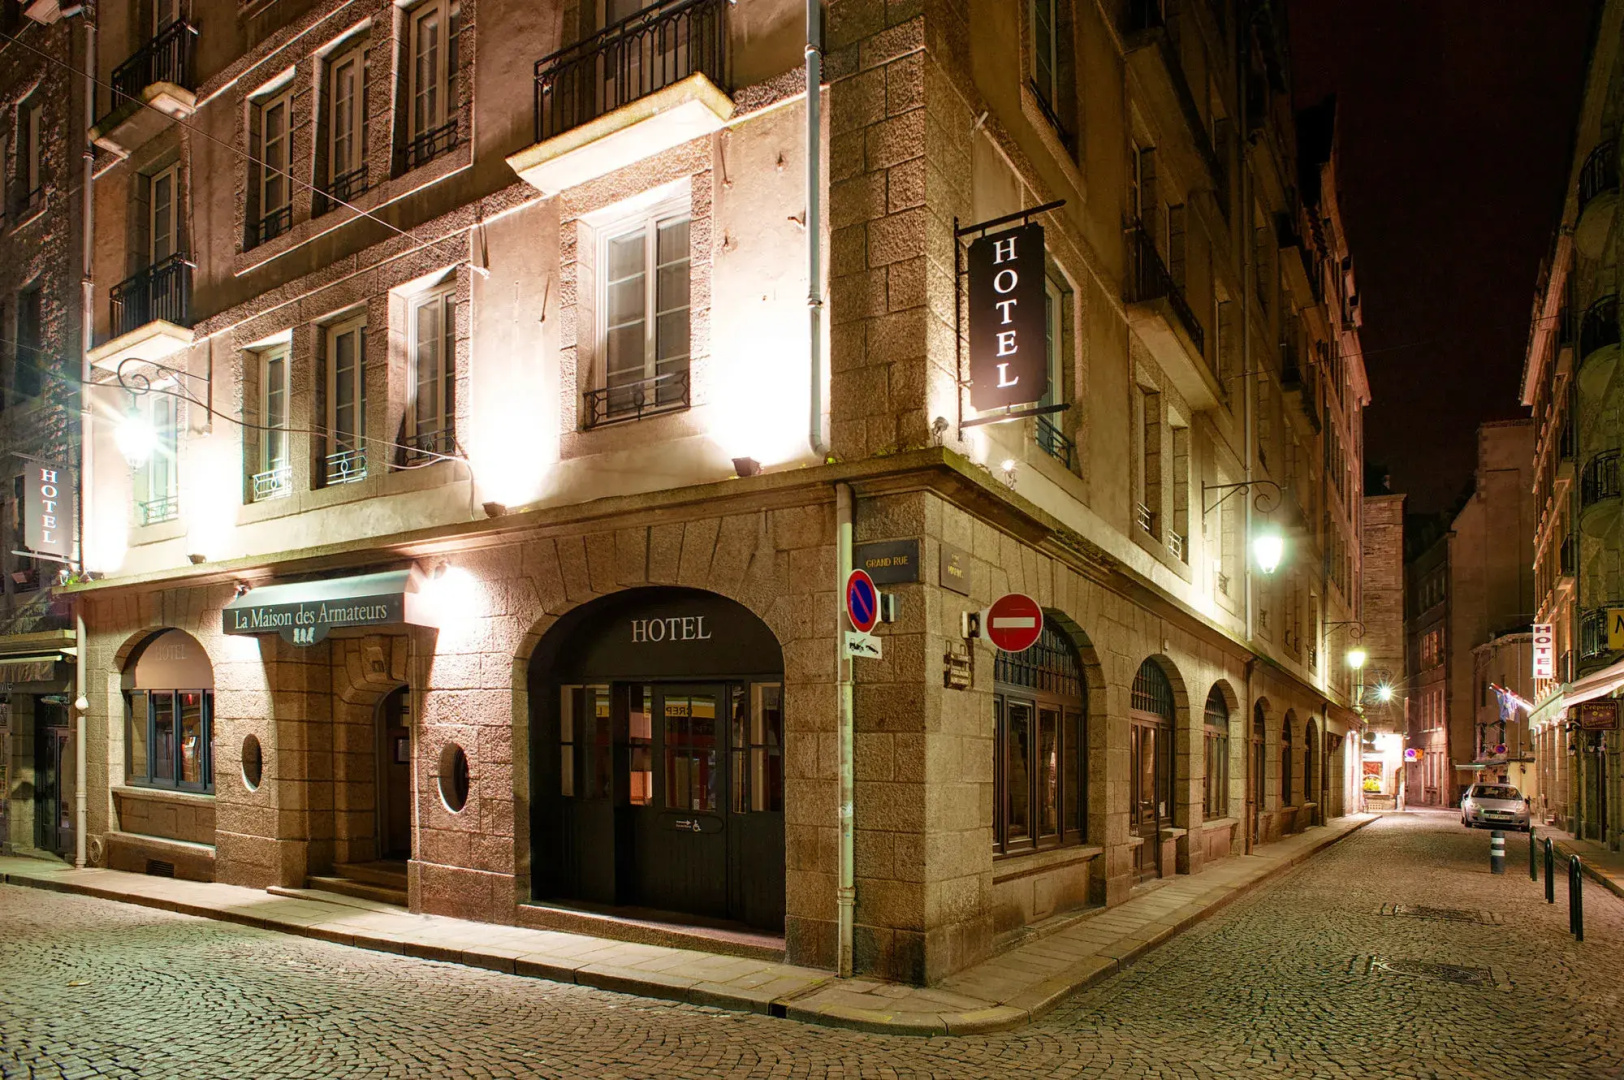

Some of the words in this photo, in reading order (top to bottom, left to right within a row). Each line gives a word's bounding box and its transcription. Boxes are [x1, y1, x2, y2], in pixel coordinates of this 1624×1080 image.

[993, 236, 1019, 388] HOTEL
[41, 468, 58, 544] HOTEL
[866, 557, 891, 569] GRAND
[893, 555, 909, 566] RUE
[234, 610, 248, 629] La
[251, 607, 292, 628] Maison
[295, 604, 315, 625] des
[318, 602, 387, 623] Armateurs
[630, 615, 712, 643] HOTEL
[1535, 626, 1551, 675] HOTEL
